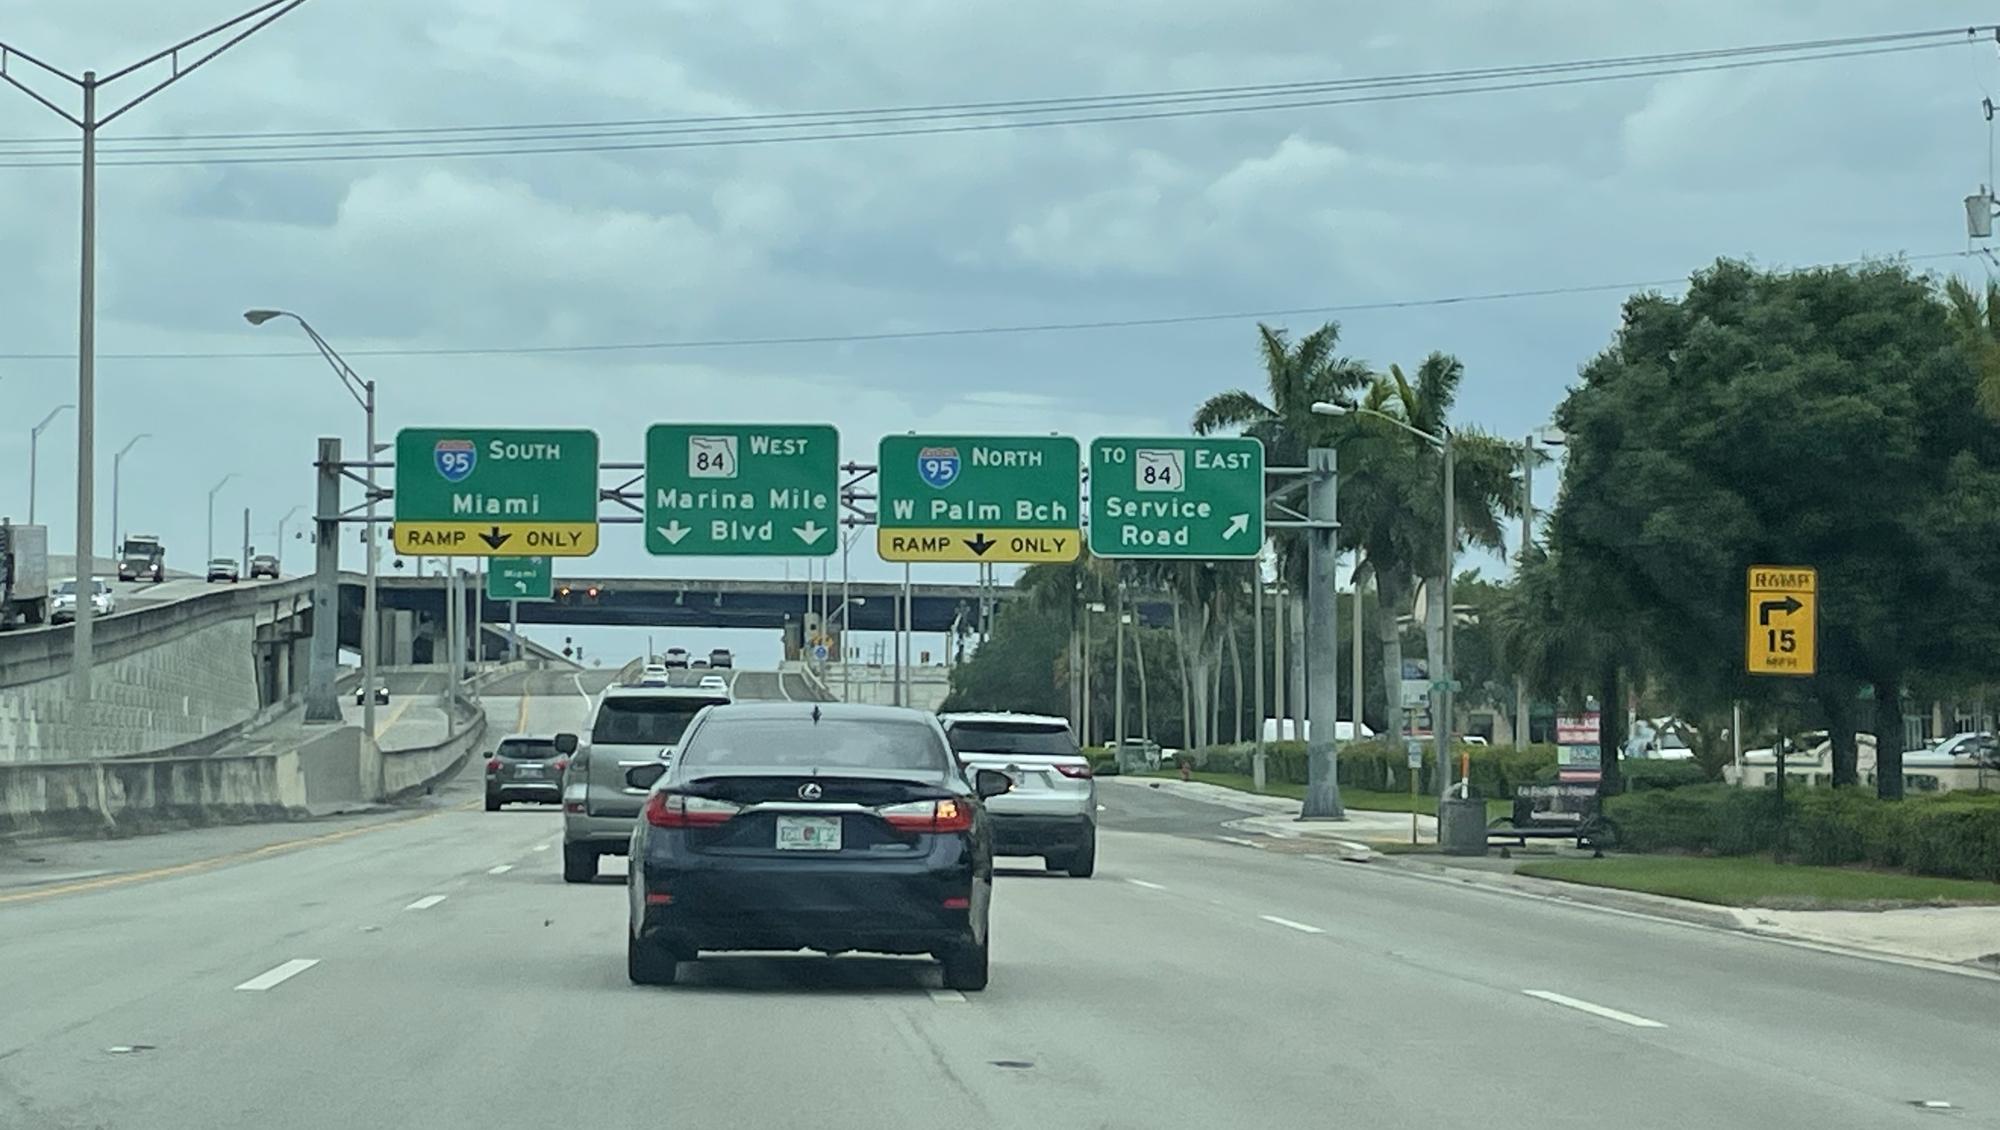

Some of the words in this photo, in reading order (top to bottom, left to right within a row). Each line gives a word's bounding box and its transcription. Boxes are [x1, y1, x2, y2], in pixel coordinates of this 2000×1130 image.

[489, 440, 560, 460] SOUTH
[750, 436, 808, 455] WEST
[1101, 447, 1126, 464] TO
[442, 453, 469, 473] 95
[697, 453, 724, 471] 84
[972, 447, 1042, 467] NORTH
[1195, 451, 1251, 469] EAST
[926, 460, 954, 480] 95
[1144, 467, 1171, 485] 84
[453, 494, 540, 514] Miami
[657, 489, 754, 510] Marina
[770, 489, 827, 510] Mile
[1107, 497, 1212, 518] Service
[894, 500, 914, 520] W
[931, 500, 1001, 521] Palm
[1016, 500, 1067, 520] Bch
[408, 531, 466, 546] RAMP
[526, 531, 583, 546] ONLY
[712, 520, 773, 541] Blvd
[1122, 525, 1189, 546] Road
[893, 537, 951, 553] RAMP
[1010, 537, 1066, 553] ONLY
[1755, 573, 1810, 587] RAMP
[1768, 629, 1796, 652] 15
